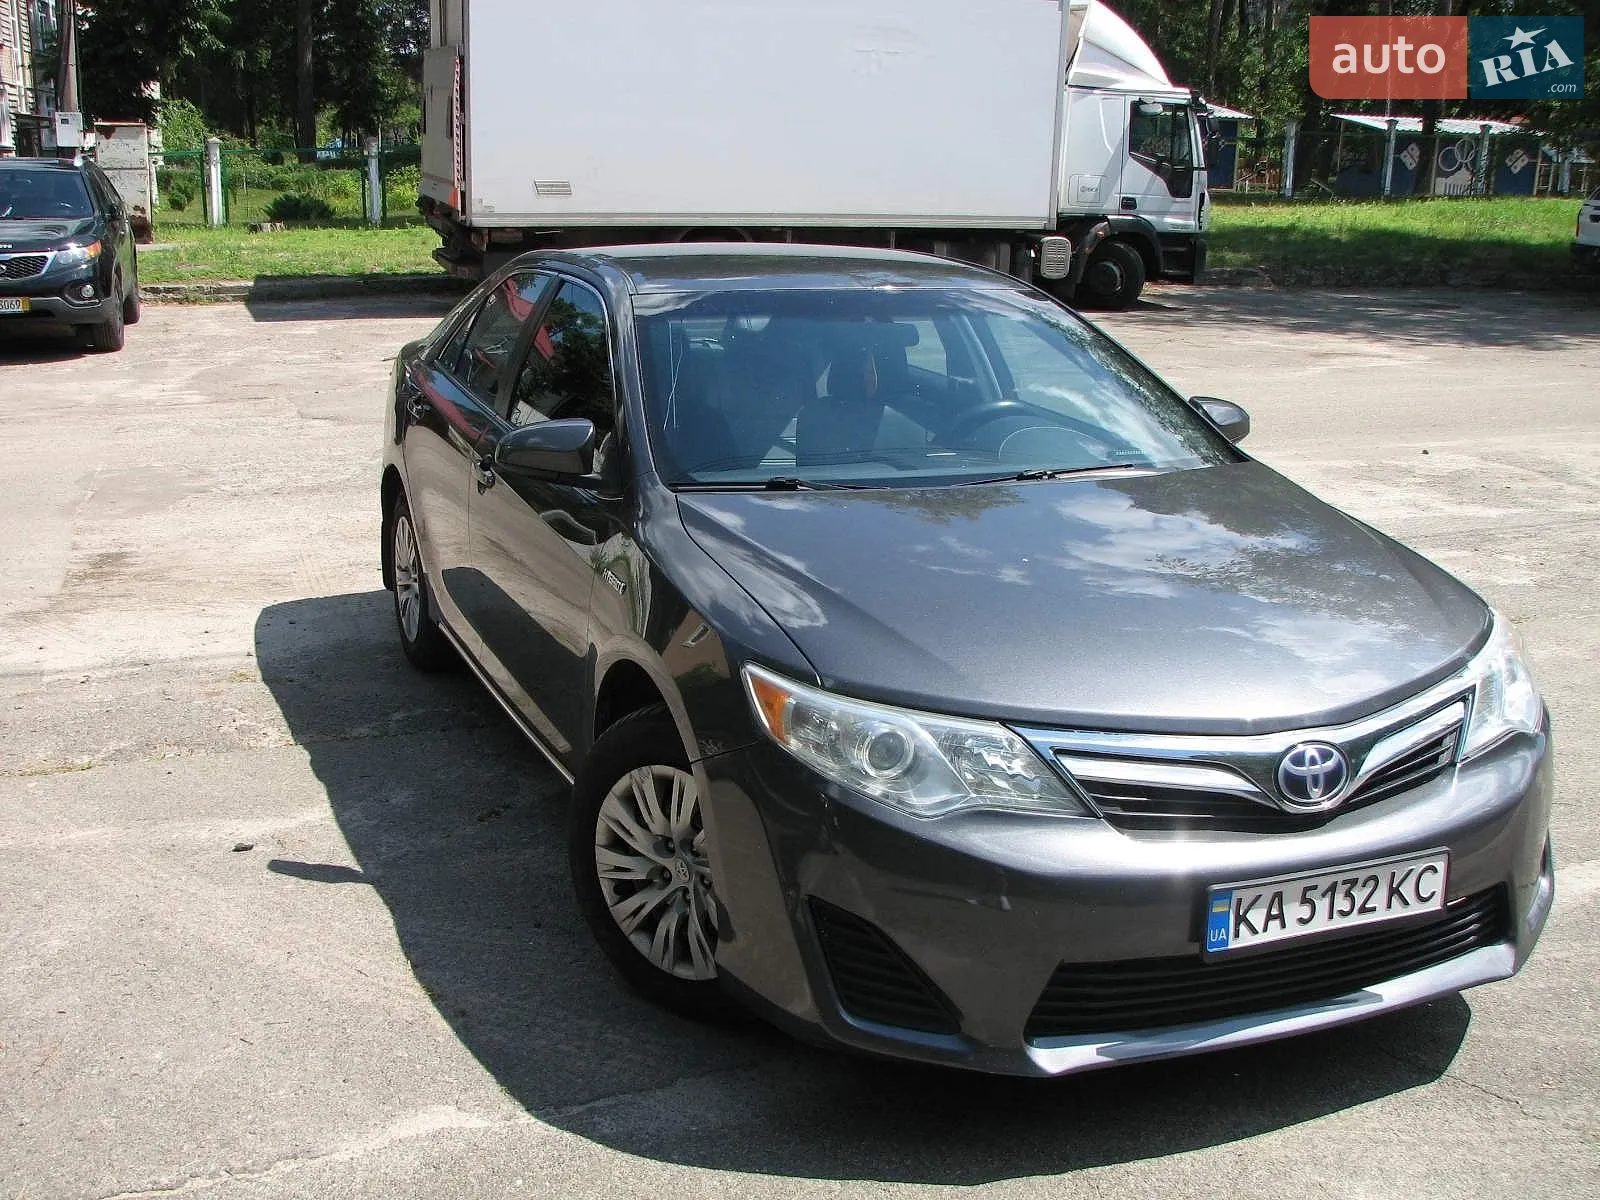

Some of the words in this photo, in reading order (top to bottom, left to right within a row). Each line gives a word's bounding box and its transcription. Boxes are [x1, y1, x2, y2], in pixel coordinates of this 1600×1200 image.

[1232, 891, 1287, 939] KA
[1296, 874, 1380, 925] 5132
[1386, 864, 1439, 910] KC
[1209, 928, 1227, 942] UA
